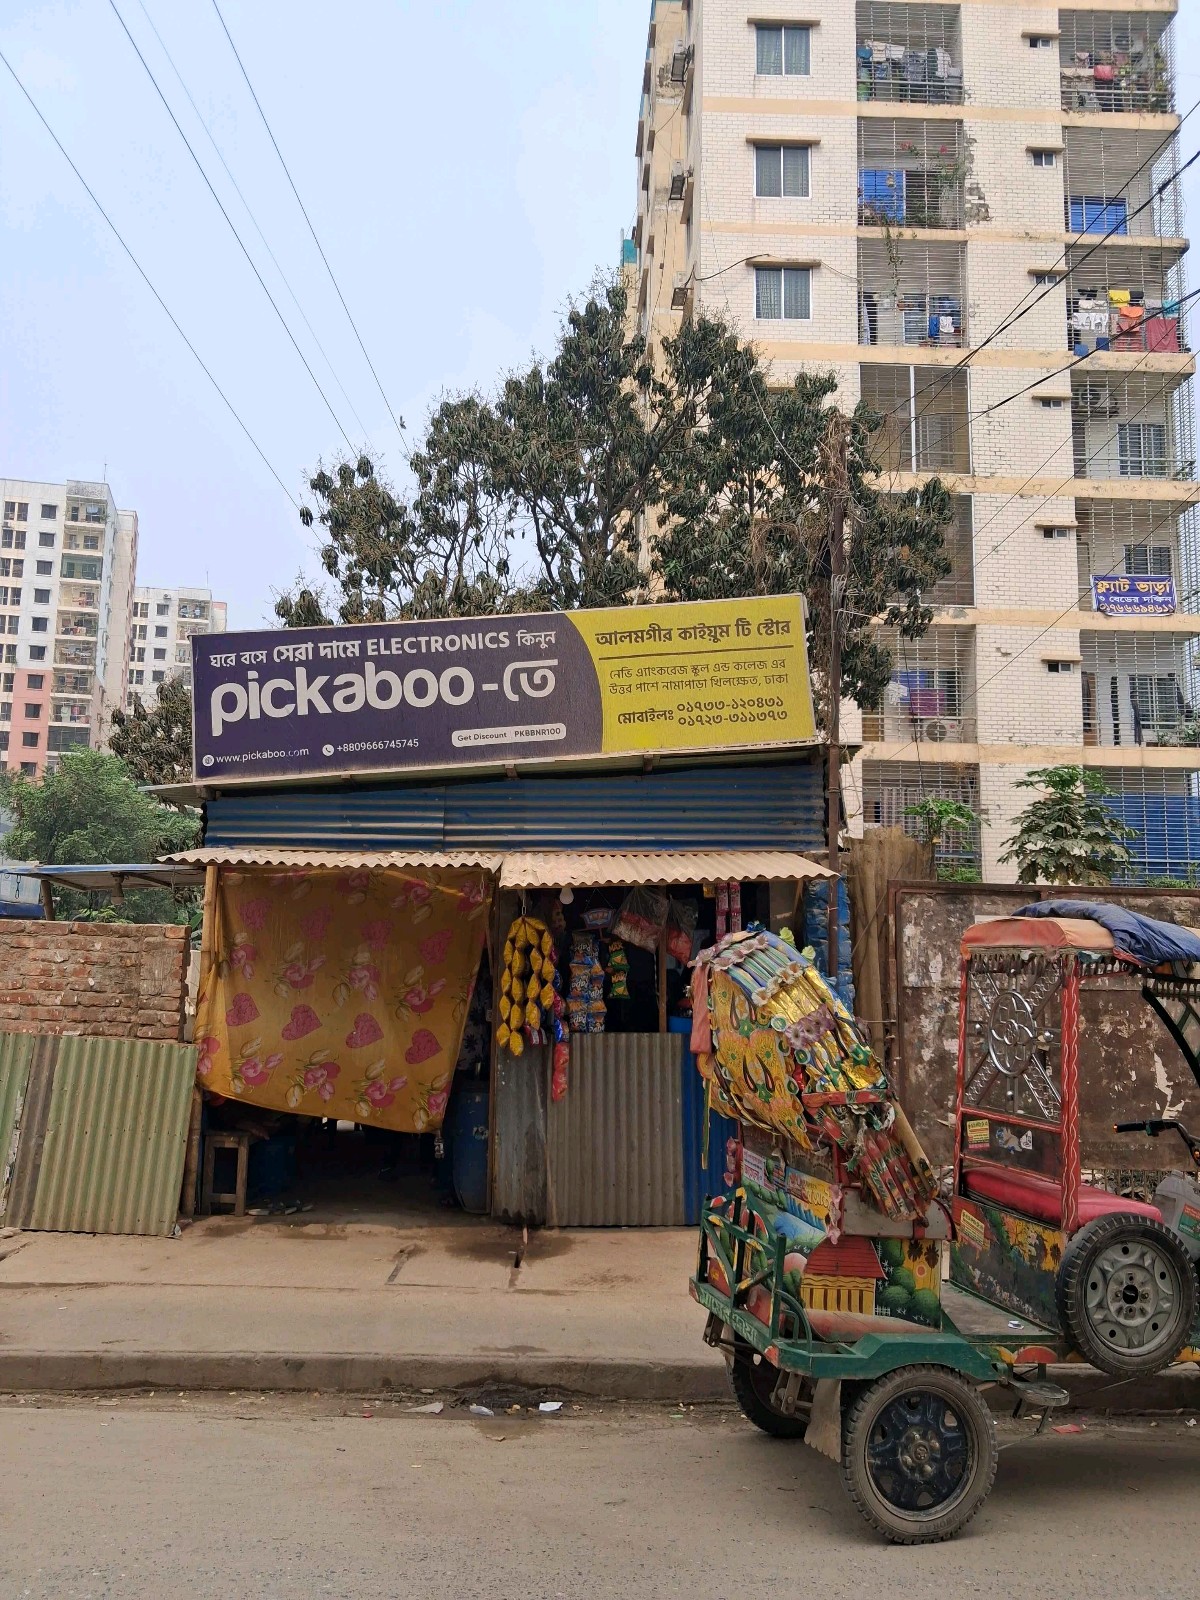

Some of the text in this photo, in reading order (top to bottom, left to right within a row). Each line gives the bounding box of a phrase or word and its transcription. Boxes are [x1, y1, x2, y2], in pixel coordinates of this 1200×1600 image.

[1134, 578, 1171, 595] ভাড়া
[595, 622, 673, 646] আলমগীর
[735, 617, 752, 637] টি
[757, 618, 792, 637] স্টোর
[210, 629, 557, 668] ঘরে বসে সেরা দামে ELECTRONICS কিনুন
[609, 667, 633, 681] নেভি
[691, 663, 710, 677] স্কুল
[713, 662, 731, 673] এন্ড
[734, 660, 768, 672] কলেজ
[771, 658, 786, 669] এর
[609, 673, 789, 695] উত্তর পাশে নামাপাড়া খিলক্ষেত, ঢাকা
[617, 696, 784, 724] মোবাইলঃ ০১৭৩৩-১২০৪৩১
[678, 709, 788, 727] ০১৭২৩-৩১১৩৭৩
[457, 727, 561, 743] Get Discount PKBBNR100
[216, 747, 309, 763] www.pickaboo.com
[336, 738, 419, 753] +8809666745745
